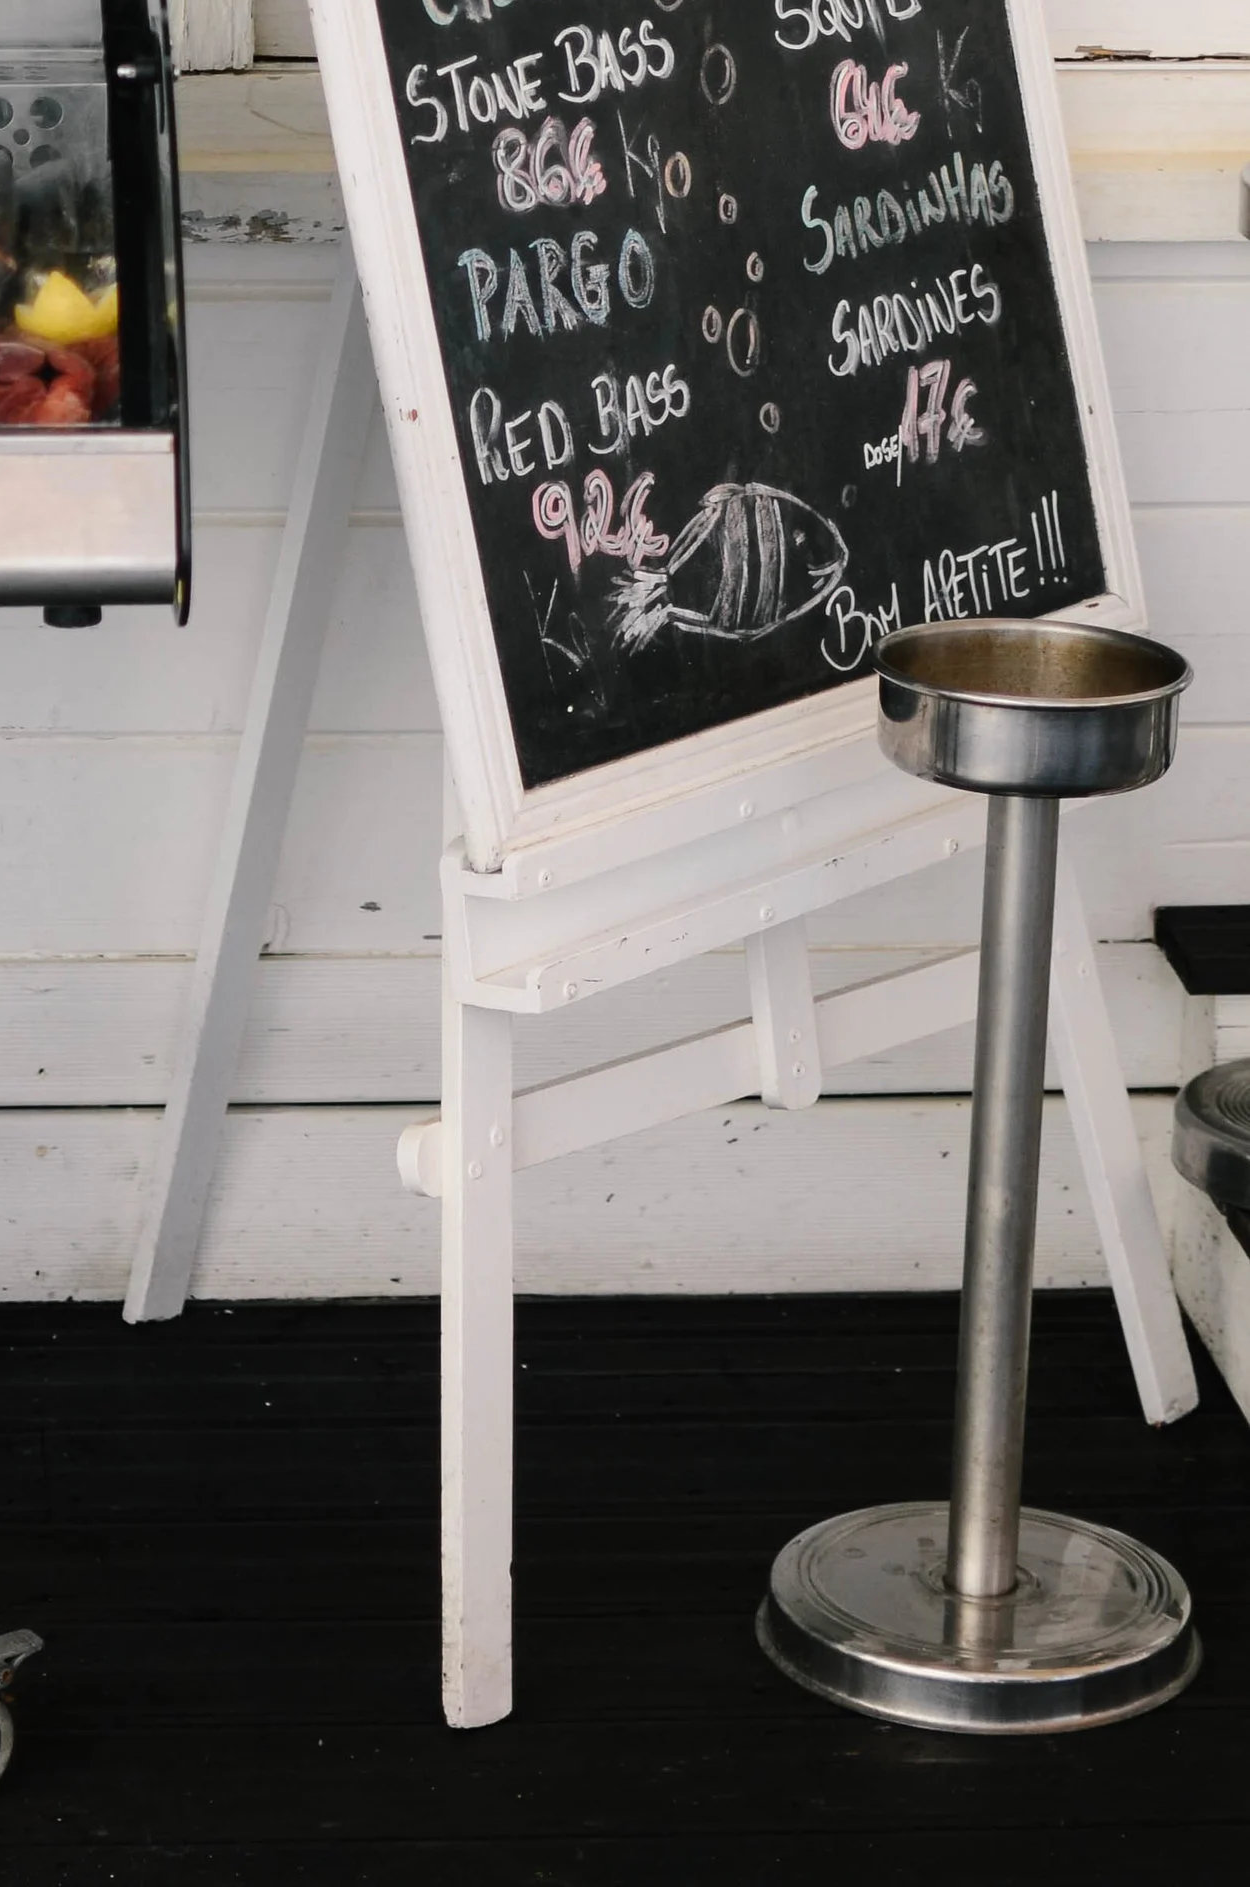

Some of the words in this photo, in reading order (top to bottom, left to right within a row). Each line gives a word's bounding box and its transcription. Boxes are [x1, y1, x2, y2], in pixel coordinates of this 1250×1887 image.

[406, 52, 547, 144] STONE
[554, 20, 675, 103] BASS
[458, 228, 655, 342] PARGO
[470, 386, 574, 485] RED
[588, 364, 690, 454] BASS
